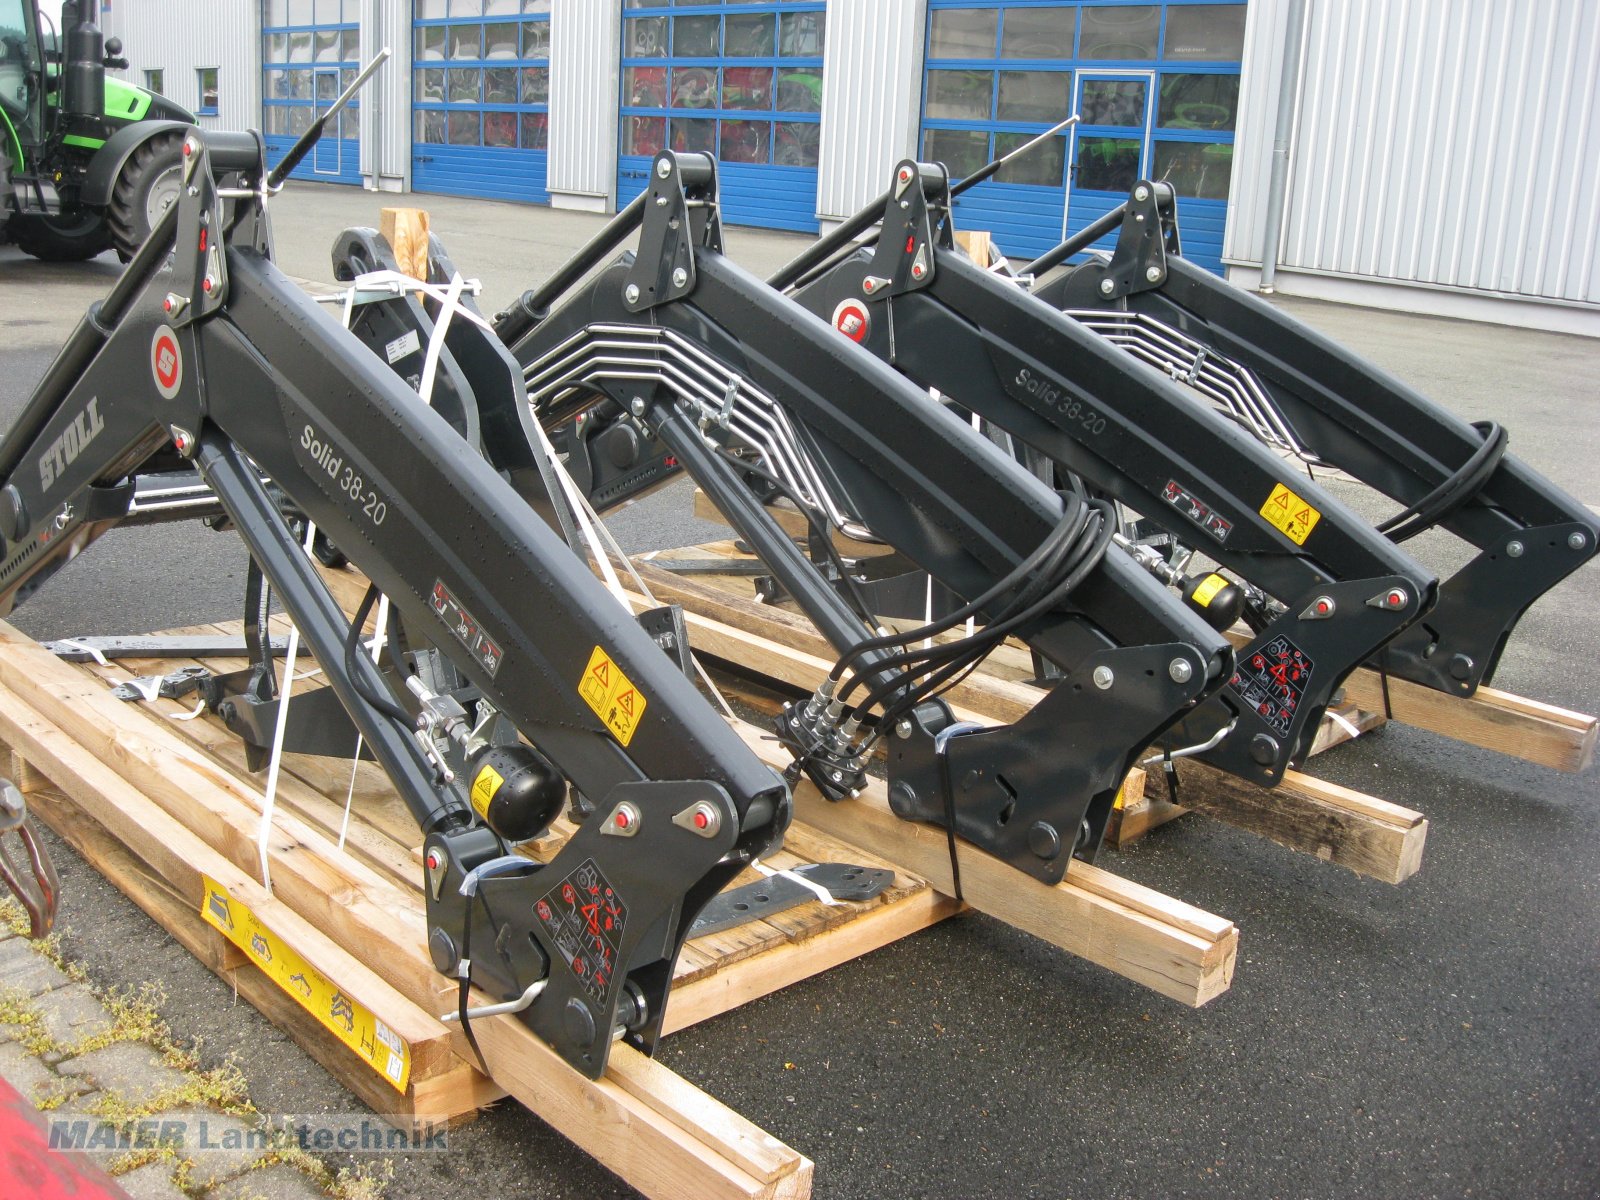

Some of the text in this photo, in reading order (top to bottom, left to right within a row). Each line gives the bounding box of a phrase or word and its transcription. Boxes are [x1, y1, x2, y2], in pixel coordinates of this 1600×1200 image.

[39, 395, 104, 493] STOLL
[1015, 368, 1106, 435] Solid 38-20
[301, 424, 386, 525] Solid 38-20
